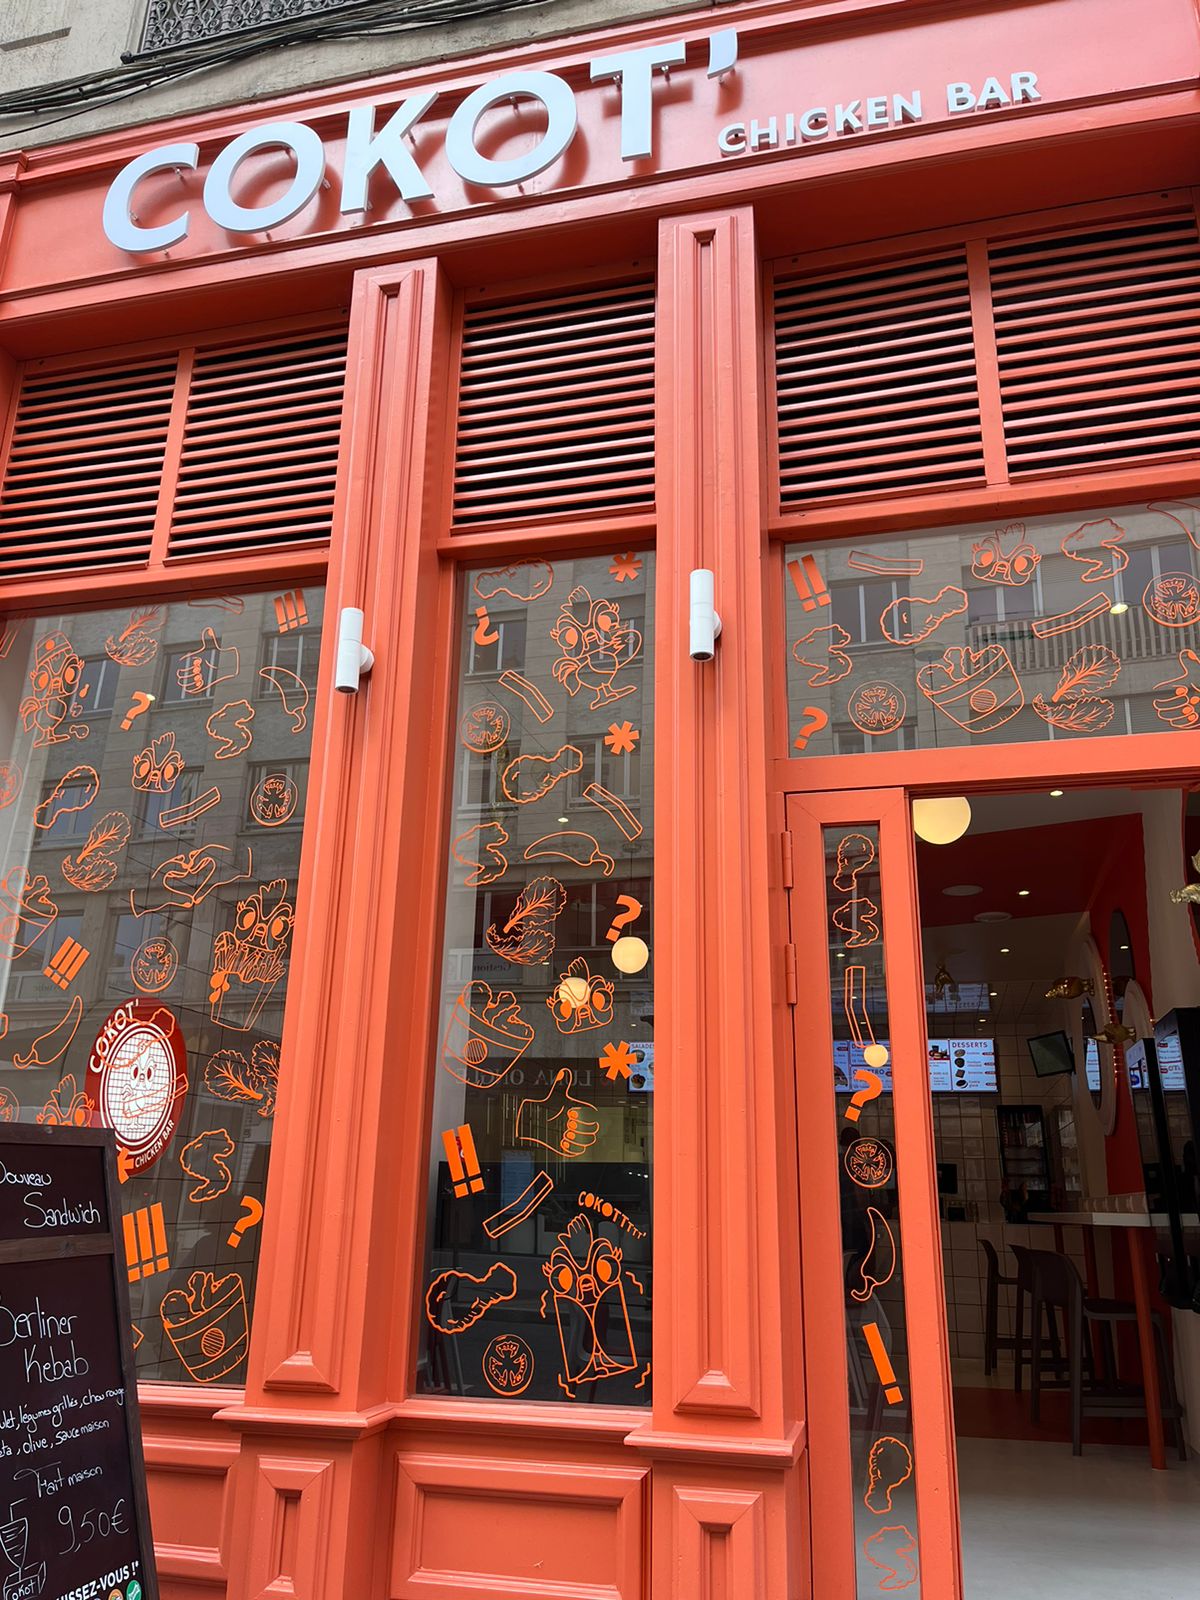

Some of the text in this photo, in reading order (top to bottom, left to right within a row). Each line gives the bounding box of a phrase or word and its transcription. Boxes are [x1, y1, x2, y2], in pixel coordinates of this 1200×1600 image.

[717, 71, 1042, 157] CHICKEN BAR
[134, 1119, 176, 1169] CHICKEN BAR
[23, 1191, 101, 1228] Sandwich
[80, 1419, 110, 1434] maison
[68, 1465, 103, 1487] maison
[58, 1498, 129, 1555] 9,50€
